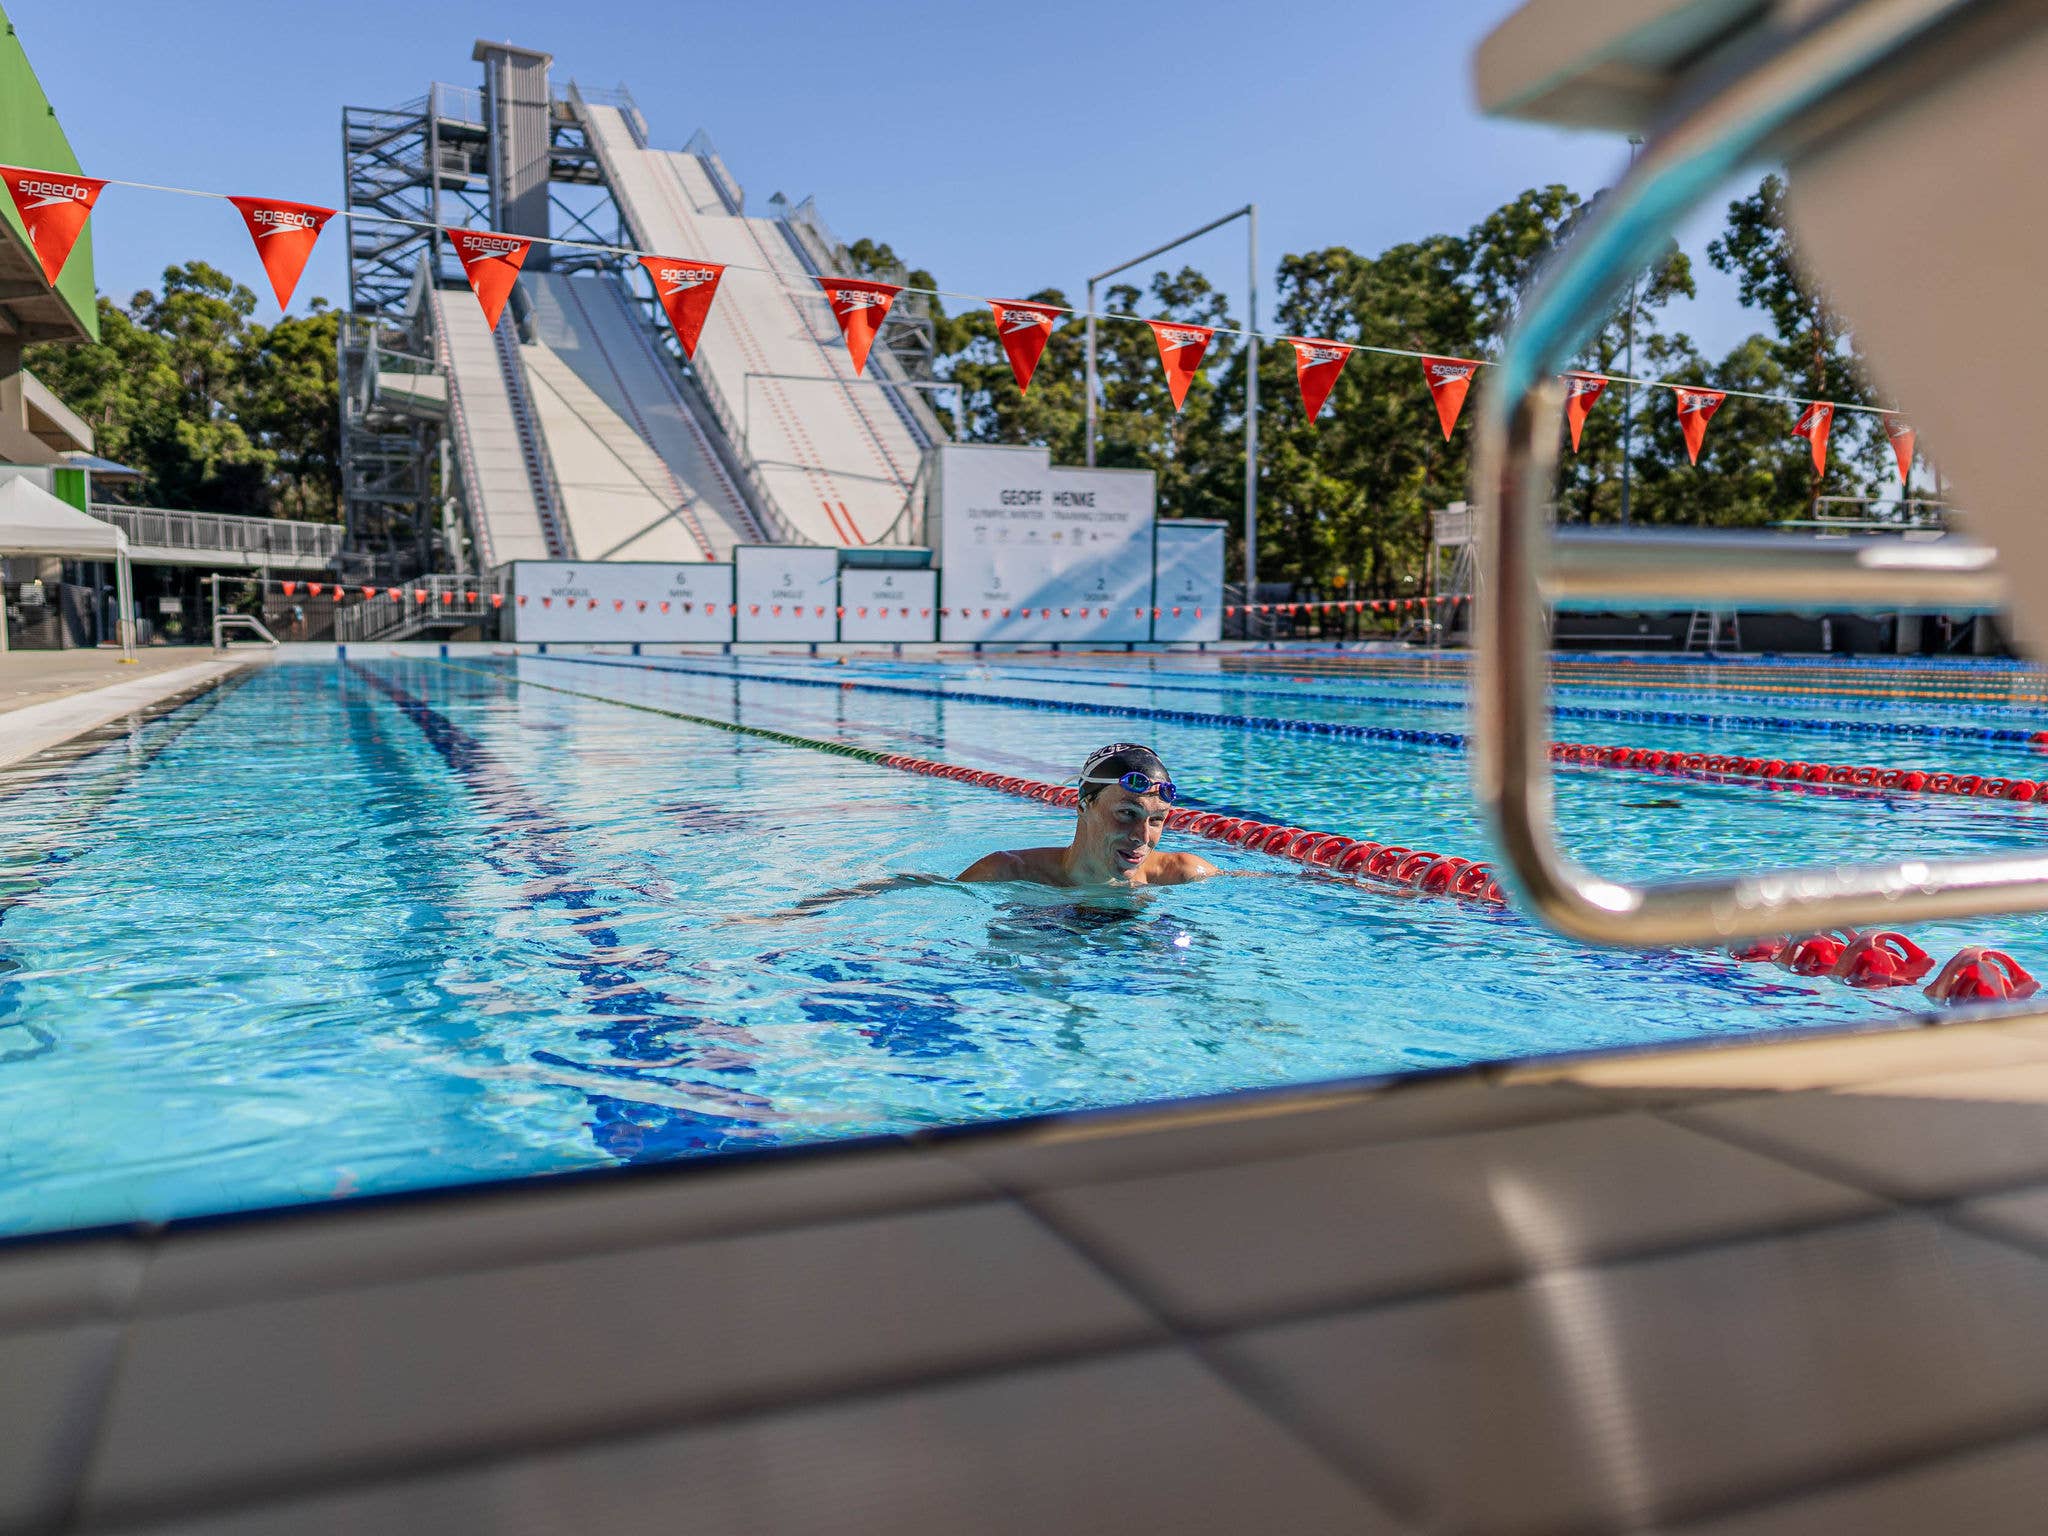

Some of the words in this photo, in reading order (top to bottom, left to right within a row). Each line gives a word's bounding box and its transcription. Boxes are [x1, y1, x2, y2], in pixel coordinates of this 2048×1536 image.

[18, 179, 88, 200] speedo
[253, 209, 316, 228] speedo
[462, 235, 521, 252] speedo
[660, 267, 715, 282] speedo
[836, 290, 886, 305] speedo
[1001, 309, 1050, 324] speedo
[1160, 328, 1206, 343] speedo
[1300, 348, 1342, 361] speedo
[1431, 364, 1470, 377] speedo
[1001, 489, 1043, 506] GEOFF
[1053, 492, 1097, 508] HENKE
[566, 570, 575, 584] 7
[676, 572, 686, 585] 6
[783, 573, 792, 587] 5
[884, 575, 893, 587] 4
[1096, 578, 1105, 591] 2
